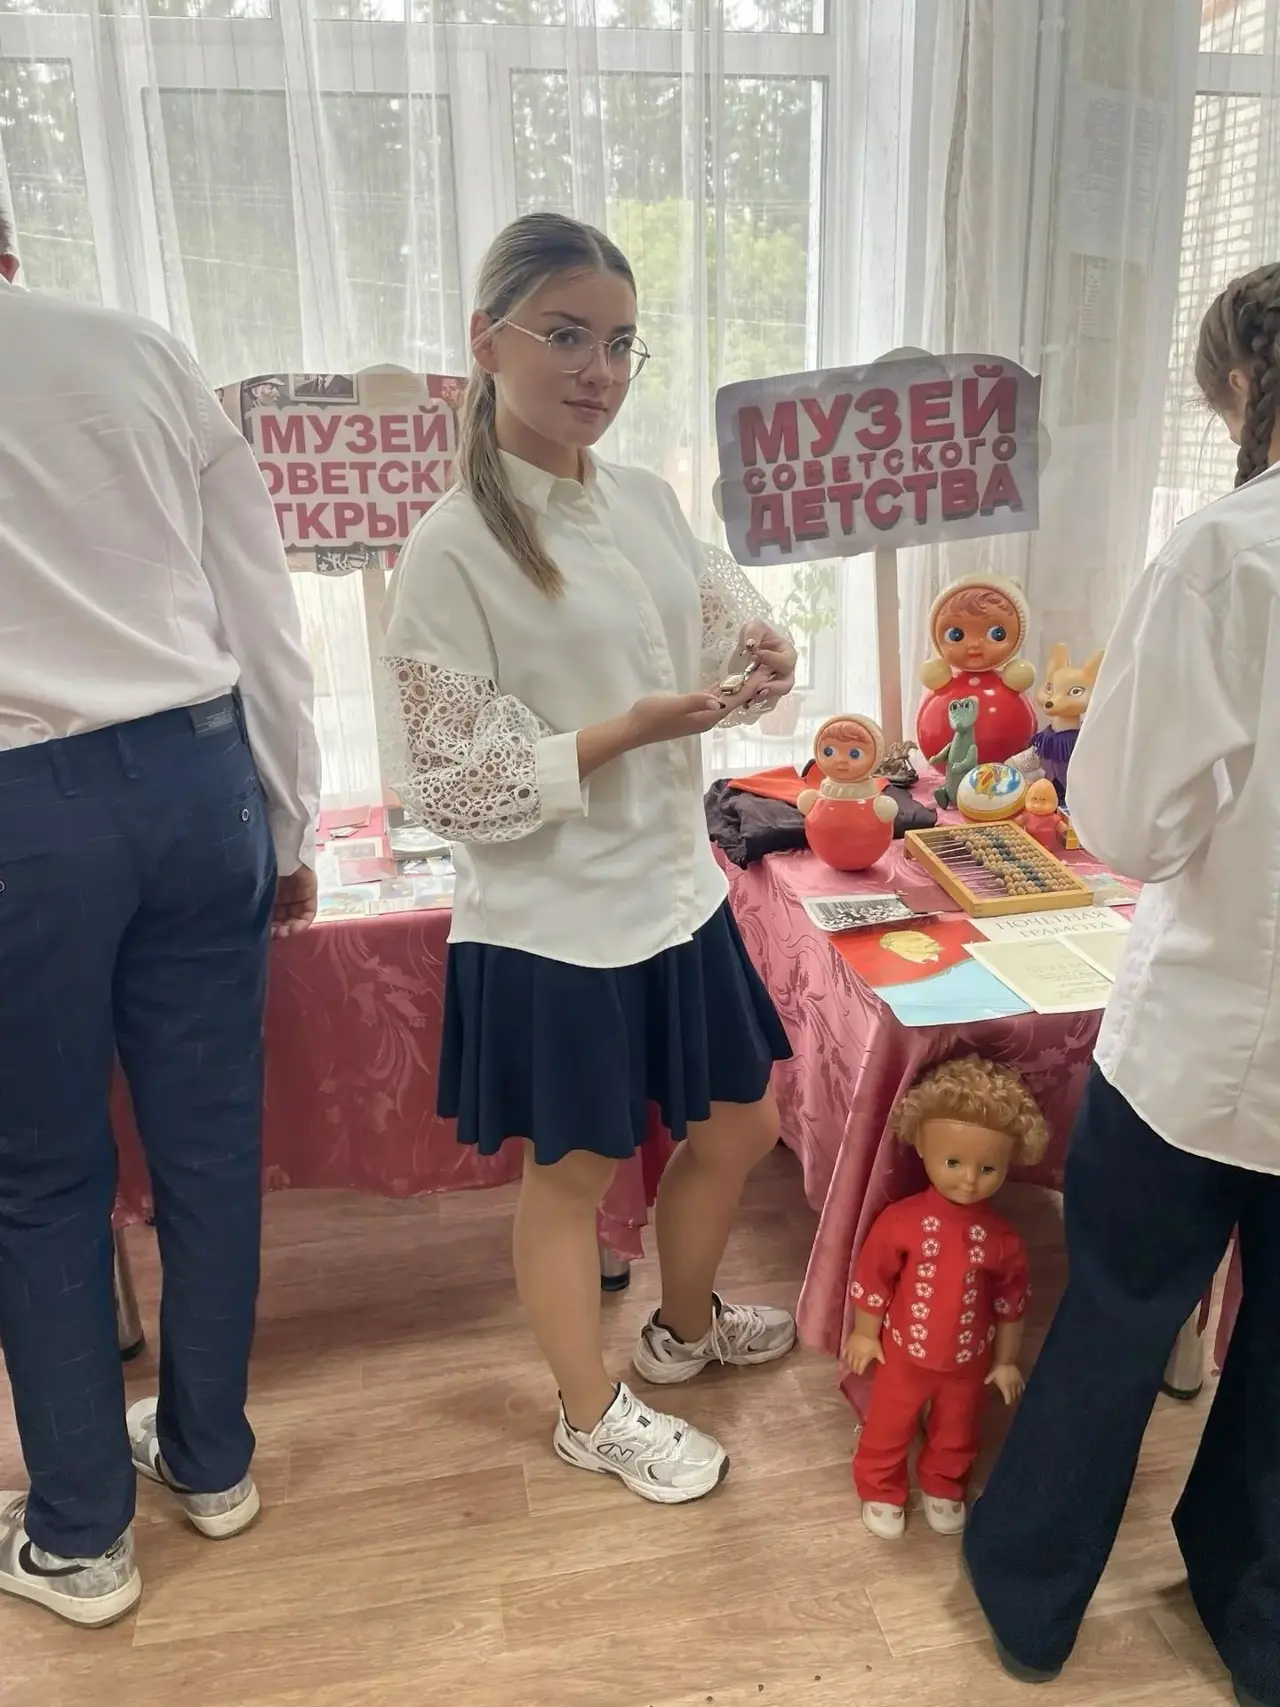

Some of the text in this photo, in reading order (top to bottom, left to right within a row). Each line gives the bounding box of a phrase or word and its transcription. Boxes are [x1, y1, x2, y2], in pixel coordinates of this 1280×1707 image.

[260, 404, 448, 454] МУЗЕЙ
[737, 364, 1018, 467] МУЗЕЙ
[258, 460, 452, 496] ОВЕТСК
[743, 435, 1018, 494] СОВЕТСКОГО
[745, 463, 1025, 558] ДЕТСТВА
